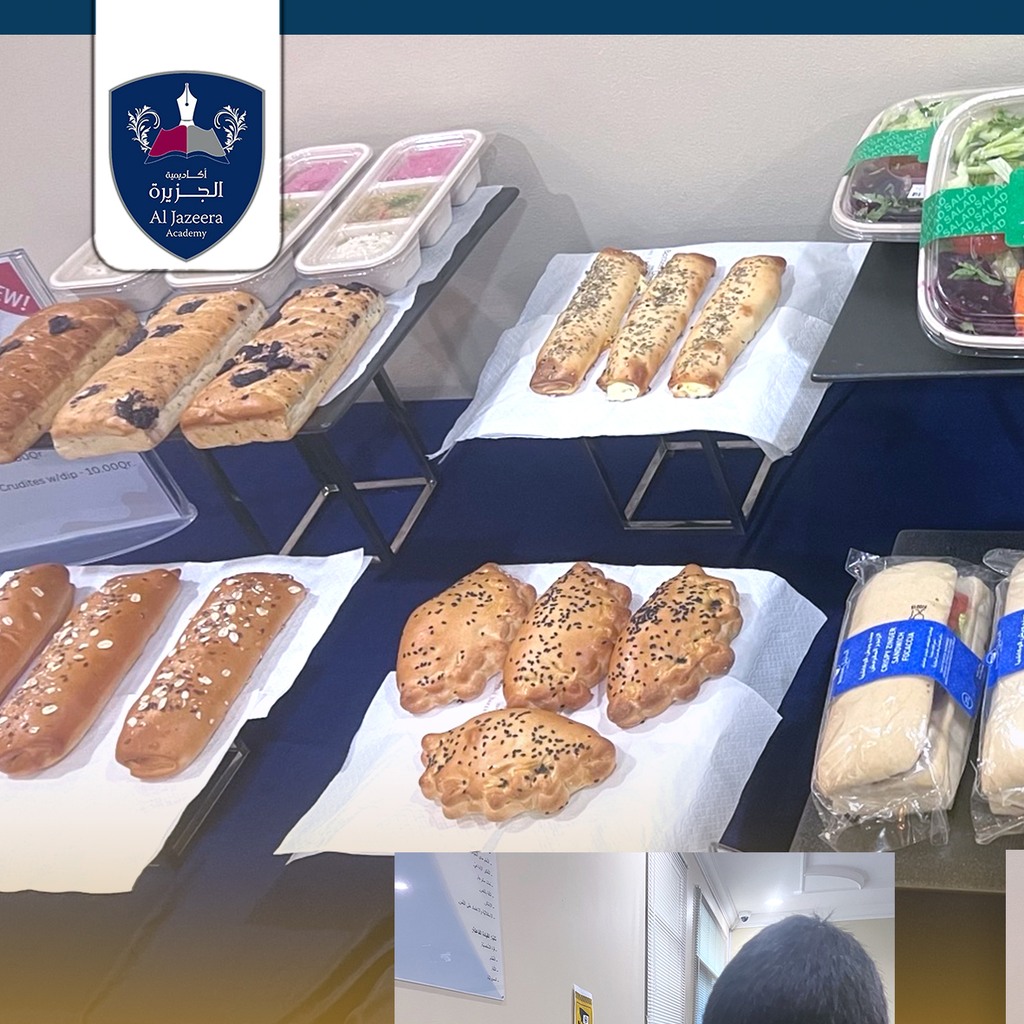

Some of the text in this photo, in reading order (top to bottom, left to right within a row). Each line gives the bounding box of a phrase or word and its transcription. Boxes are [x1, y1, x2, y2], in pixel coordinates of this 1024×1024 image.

[944, 194, 976, 224] SALAD
[974, 192, 1008, 222] SALAD
[0, 478, 46, 492] Crudites
[46, 471, 79, 483] w/dip
[880, 627, 897, 673] CRISPY ZINGER
[891, 631, 905, 664] SANDWICH
[901, 632, 915, 661] FOCACCIA
